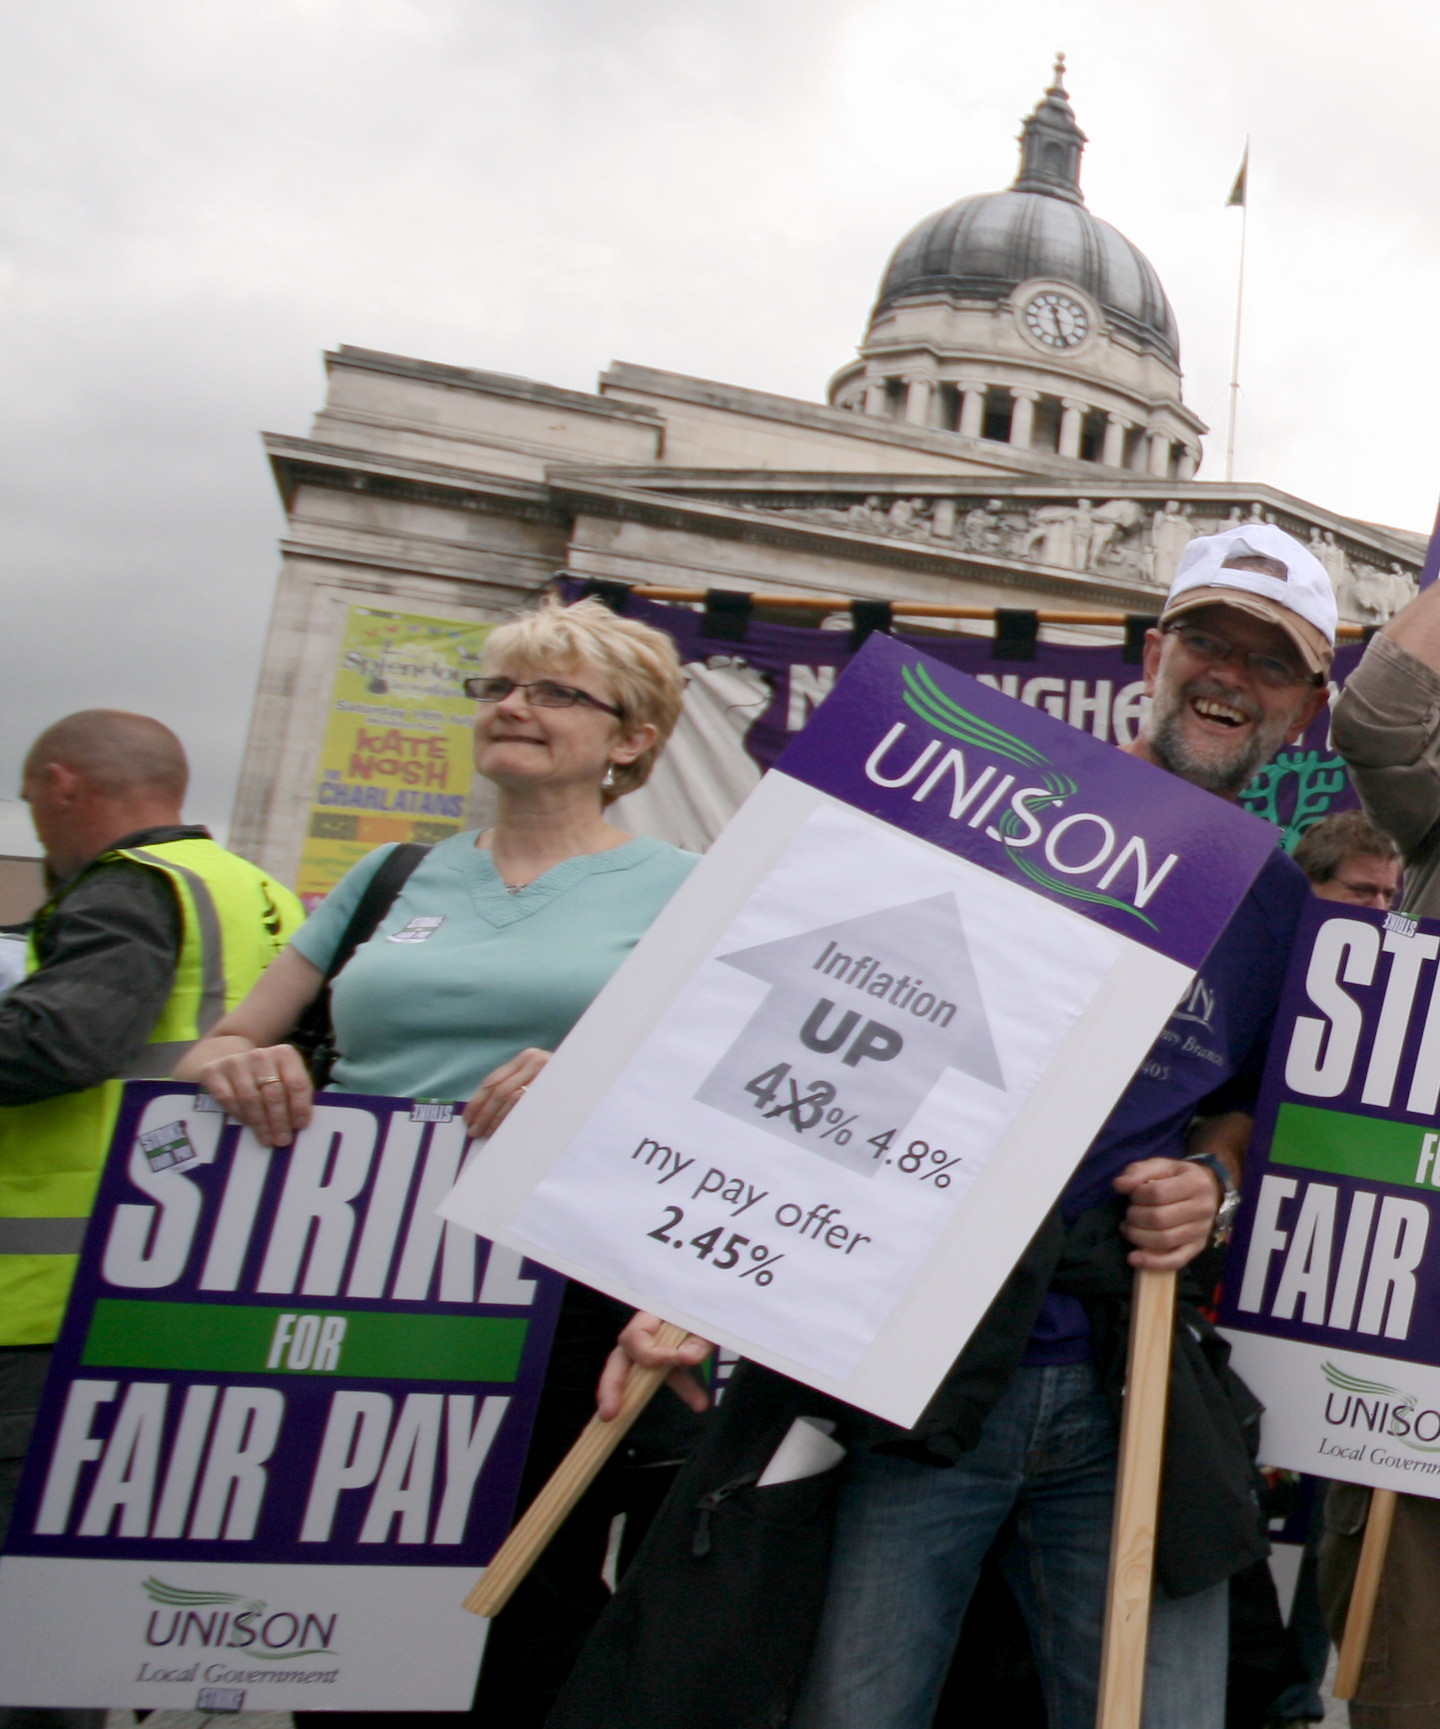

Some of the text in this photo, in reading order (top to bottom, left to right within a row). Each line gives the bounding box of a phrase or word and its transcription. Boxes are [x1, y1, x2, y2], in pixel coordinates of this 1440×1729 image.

[355, 727, 450, 760] KATE
[317, 781, 465, 819] CHARLATANS
[864, 722, 1178, 909] UNISON
[811, 940, 958, 1029] Inflation
[798, 996, 903, 1068] UP
[866, 1128, 963, 1189] 4.8%
[632, 1134, 872, 1255] my pay offer
[646, 1205, 786, 1287] 2.45%
[1237, 1175, 1431, 1342] FAIR
[266, 1313, 348, 1371] FOR
[33, 1379, 512, 1546] FAIR PAY
[1318, 1437, 1367, 1462] Local
[146, 1608, 338, 1649] UNISON
[135, 1661, 340, 1684] Local Government
